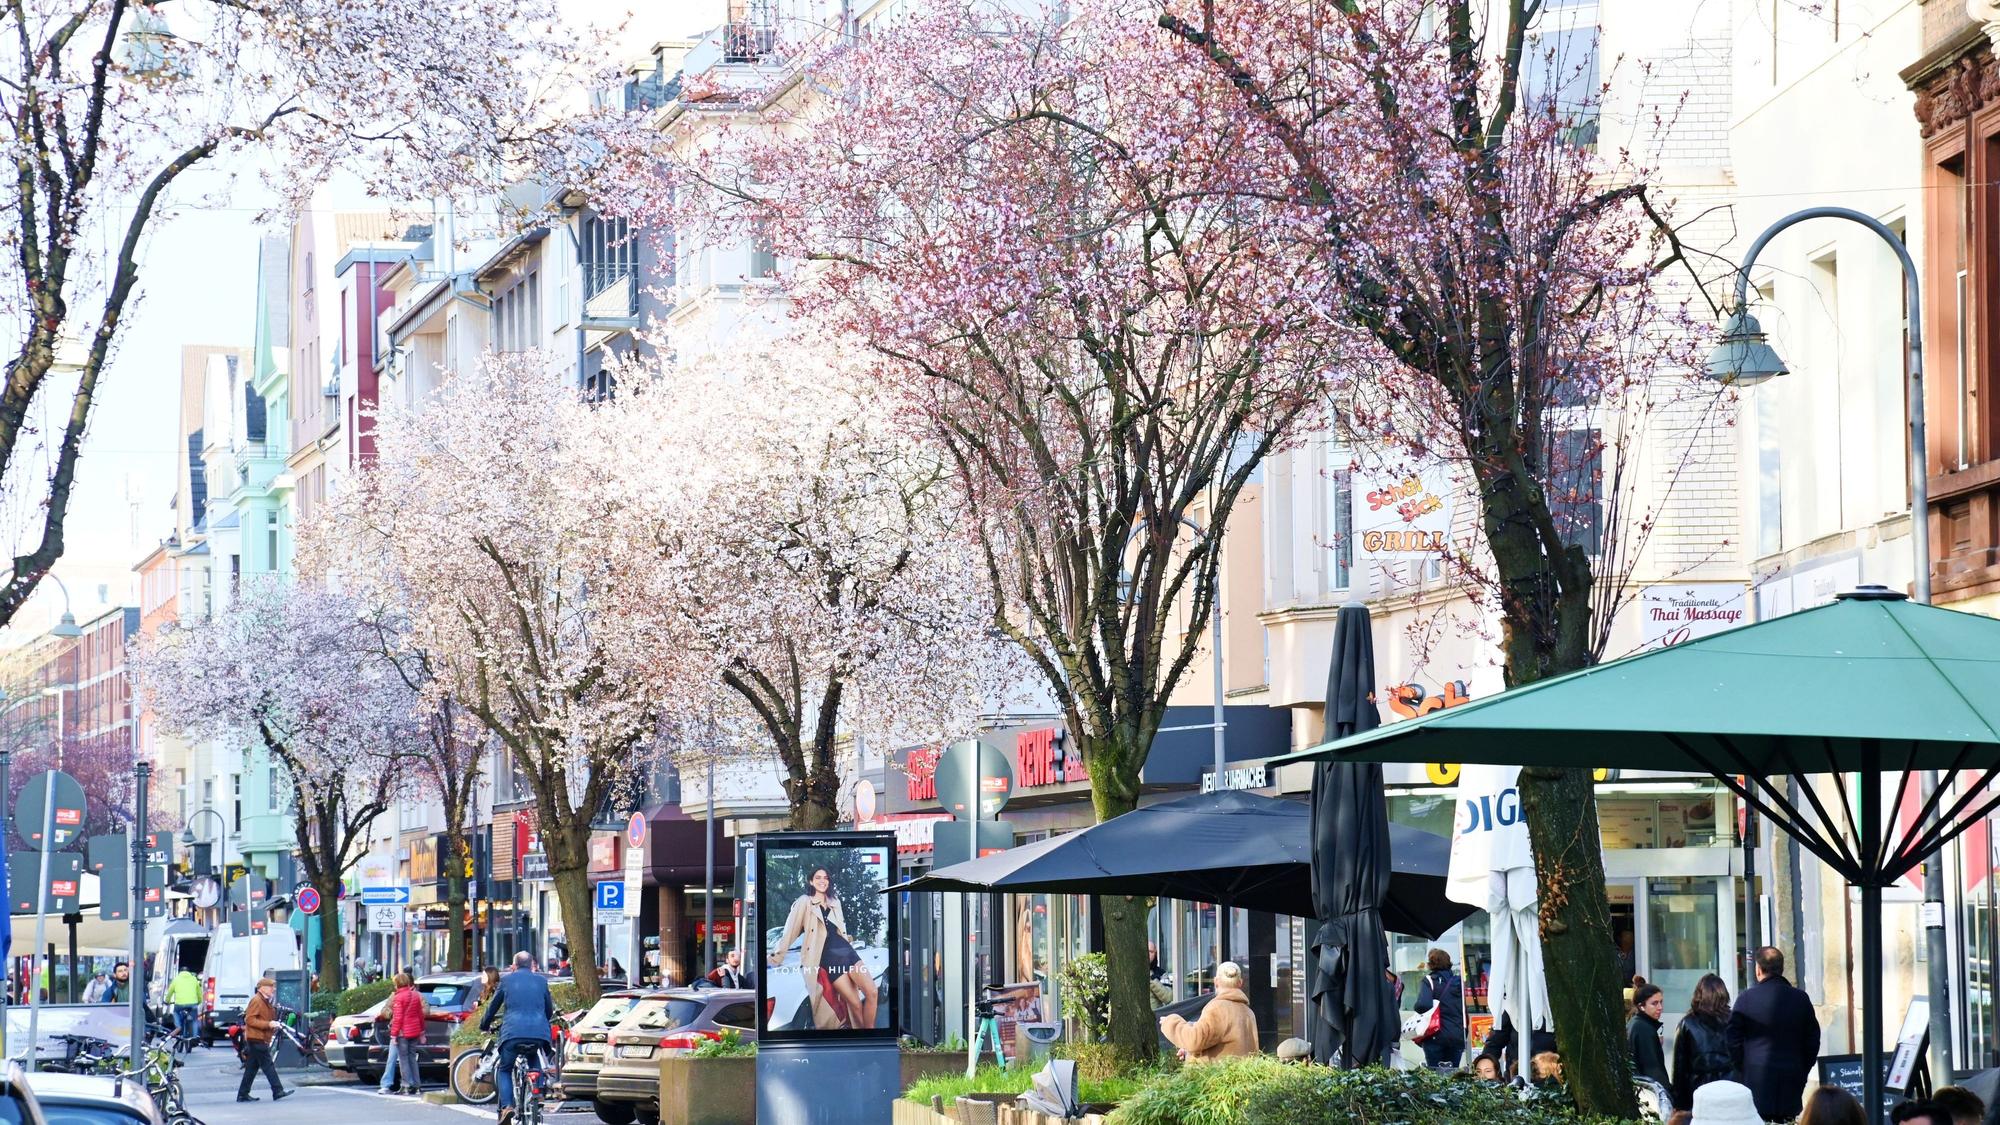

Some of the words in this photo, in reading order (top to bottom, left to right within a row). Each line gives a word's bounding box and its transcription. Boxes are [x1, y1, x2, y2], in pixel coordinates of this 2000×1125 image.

[1363, 531, 1448, 552] GRILL
[1671, 599, 1719, 607] Traditionelle
[1650, 608, 1680, 621] Thai
[1684, 607, 1742, 624] Massage
[1017, 728, 1063, 787] REWE
[1229, 767, 1267, 790] UHRMACHER
[603, 885, 618, 906] P
[773, 966, 820, 976] TOMMY
[829, 965, 881, 974] HILFIG
